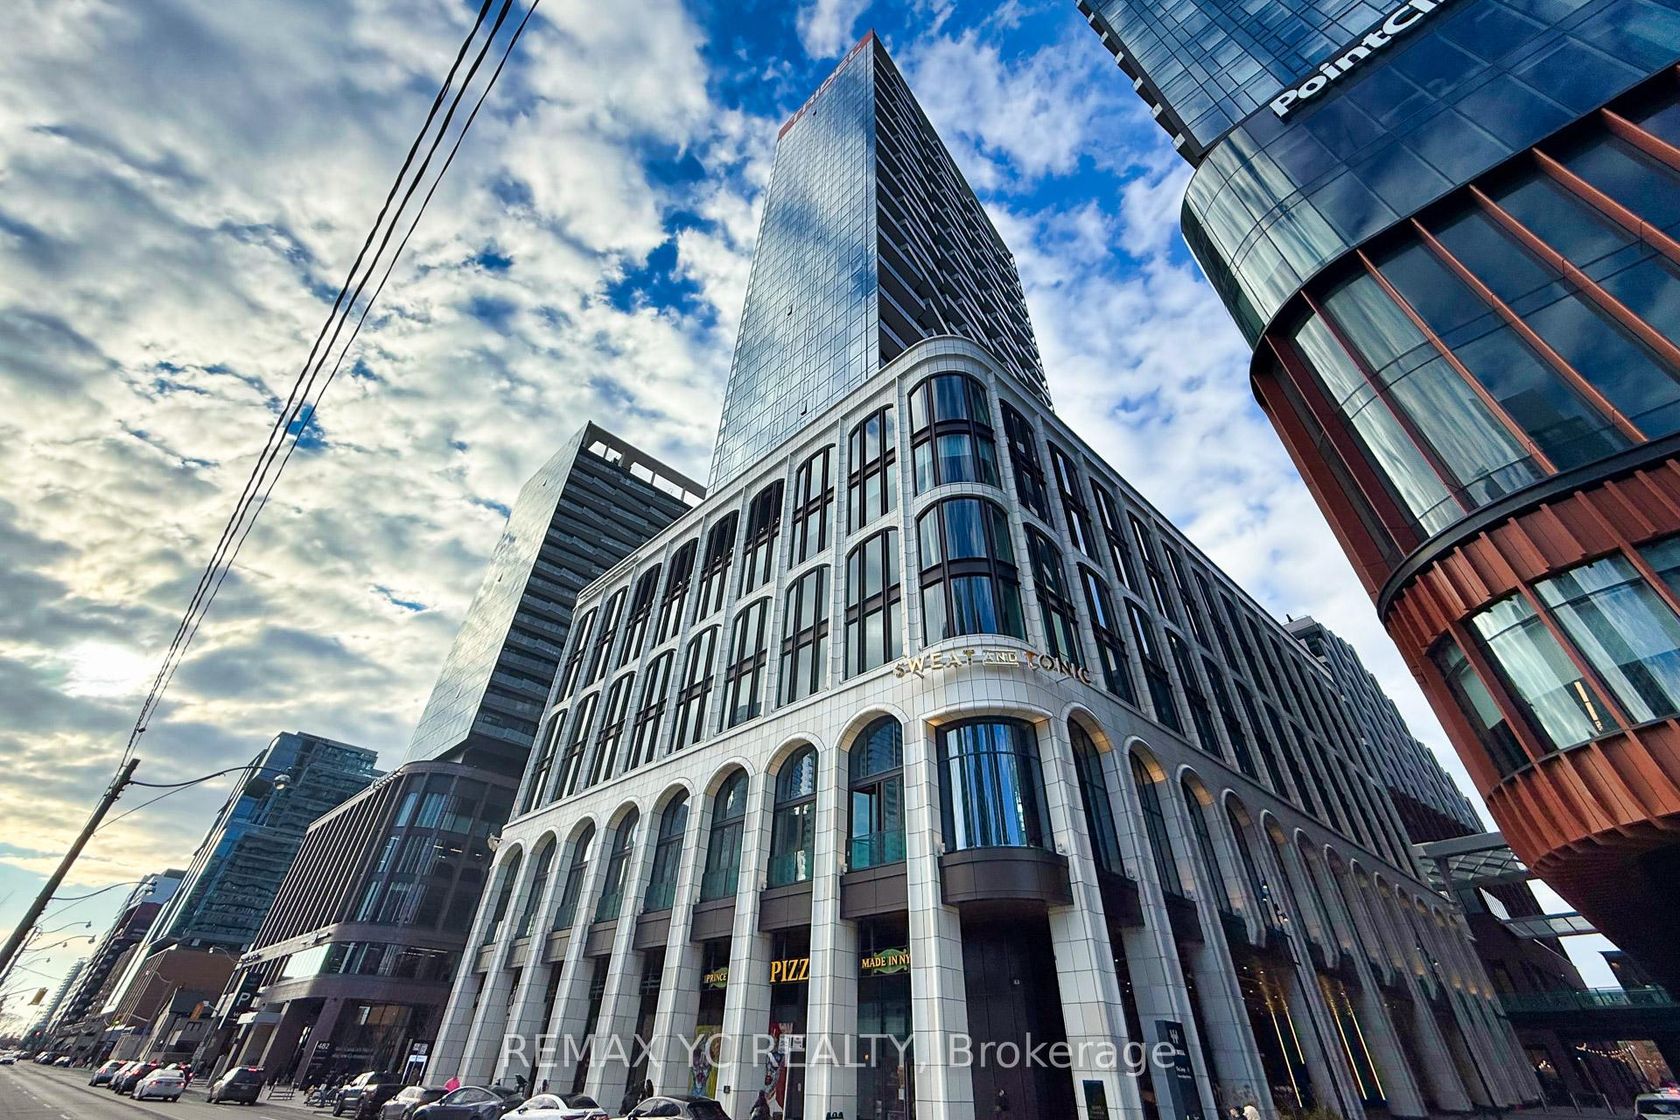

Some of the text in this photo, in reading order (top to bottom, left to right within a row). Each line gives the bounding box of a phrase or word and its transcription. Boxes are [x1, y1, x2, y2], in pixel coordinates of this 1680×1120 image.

[1269, 0, 1445, 118] PointCl
[893, 649, 1093, 684] SWEAT AND TONIC
[862, 957, 887, 969] MADE
[888, 955, 898, 966] IN
[705, 972, 727, 984] PRINCE
[236, 992, 251, 1006] P
